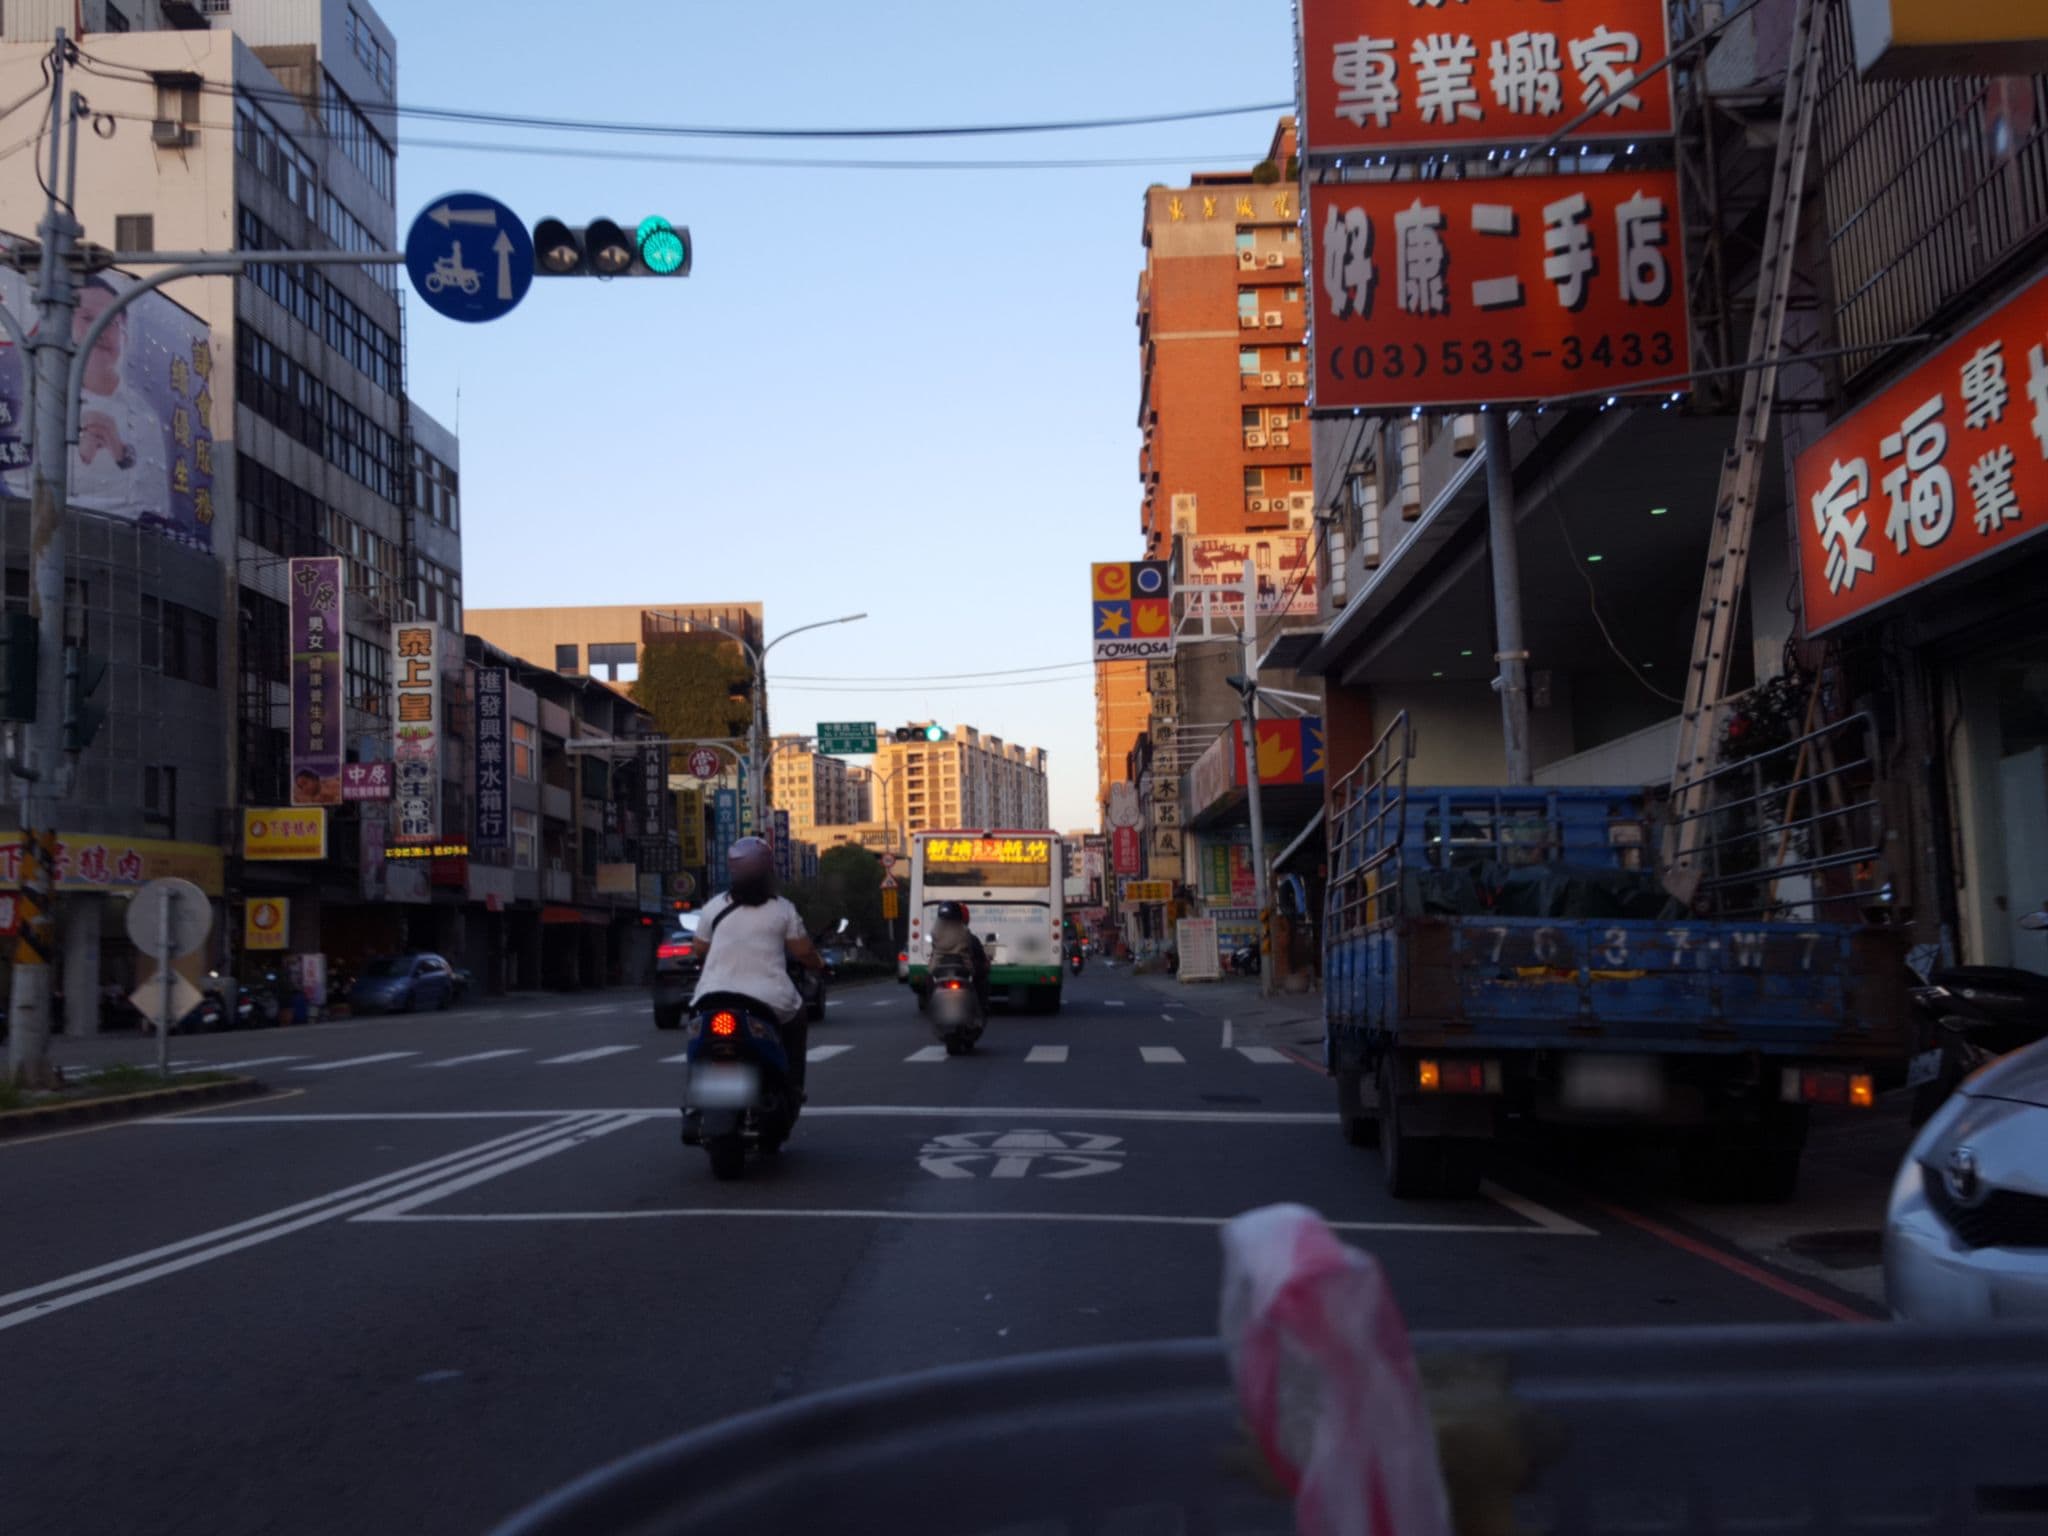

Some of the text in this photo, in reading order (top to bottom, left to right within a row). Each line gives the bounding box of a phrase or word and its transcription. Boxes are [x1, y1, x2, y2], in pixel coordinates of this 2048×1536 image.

[1332, 25, 1643, 128] 專業搬家
[1323, 190, 1668, 317] 好康二手店
[1329, 332, 1675, 380] (03)533-3433
[1811, 392, 1956, 595] 家福
[1960, 339, 2022, 535] 專業
[397, 628, 433, 722] 泰上皇
[1097, 642, 1169, 658] FORMOSA
[348, 764, 388, 785] 中原
